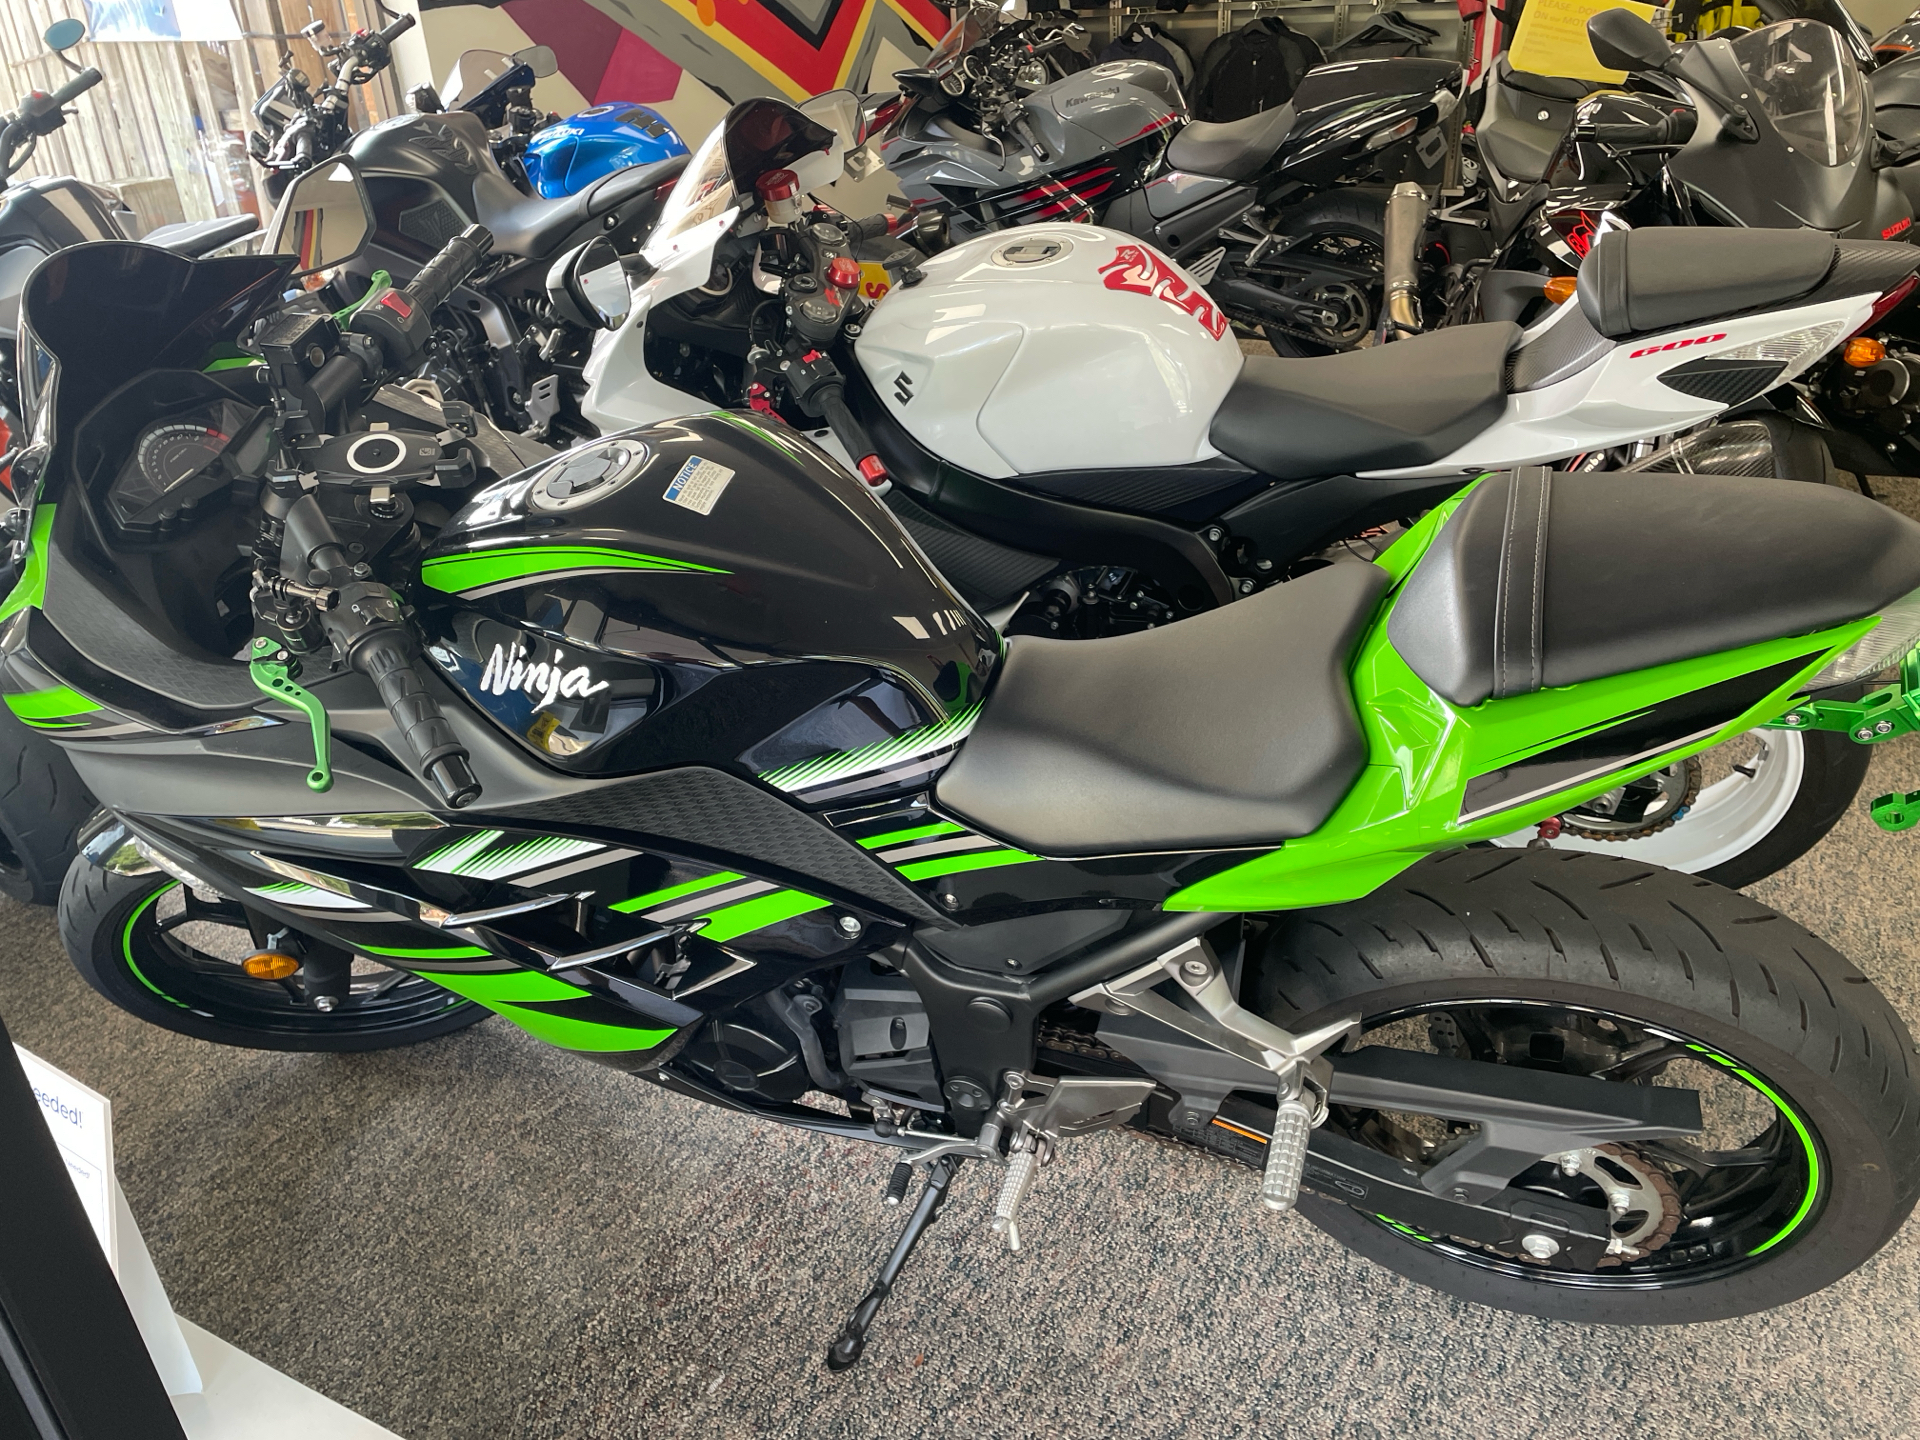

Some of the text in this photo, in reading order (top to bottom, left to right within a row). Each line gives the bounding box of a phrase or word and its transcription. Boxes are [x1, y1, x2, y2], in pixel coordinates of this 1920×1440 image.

[1533, 10, 1549, 20] ON
[1562, 16, 1587, 27] MOT
[1629, 333, 1727, 358] 600
[673, 462, 698, 491] NOTICE
[480, 641, 609, 714] Ninja
[33, 1086, 83, 1129] eeded!
